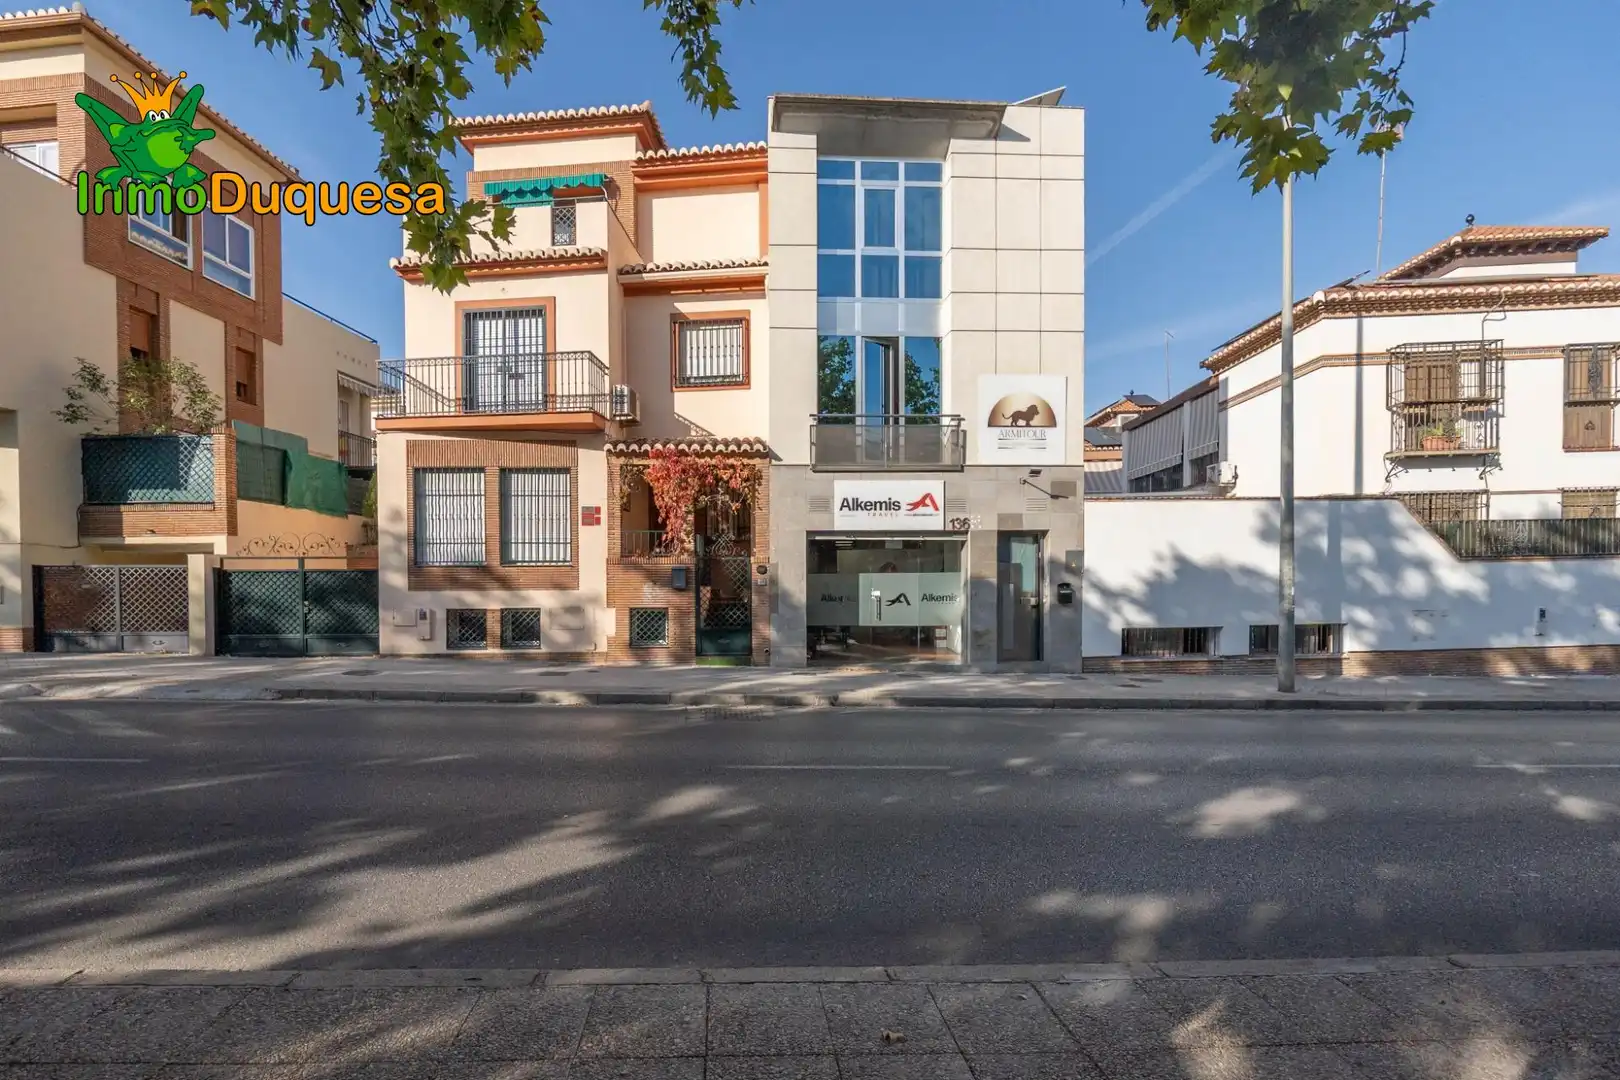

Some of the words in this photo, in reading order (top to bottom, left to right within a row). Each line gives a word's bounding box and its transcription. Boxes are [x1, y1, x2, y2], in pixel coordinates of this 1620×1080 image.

[998, 428, 1047, 438] ARMITOUR
[839, 497, 901, 511] Alkemis
[949, 517, 970, 530] 136
